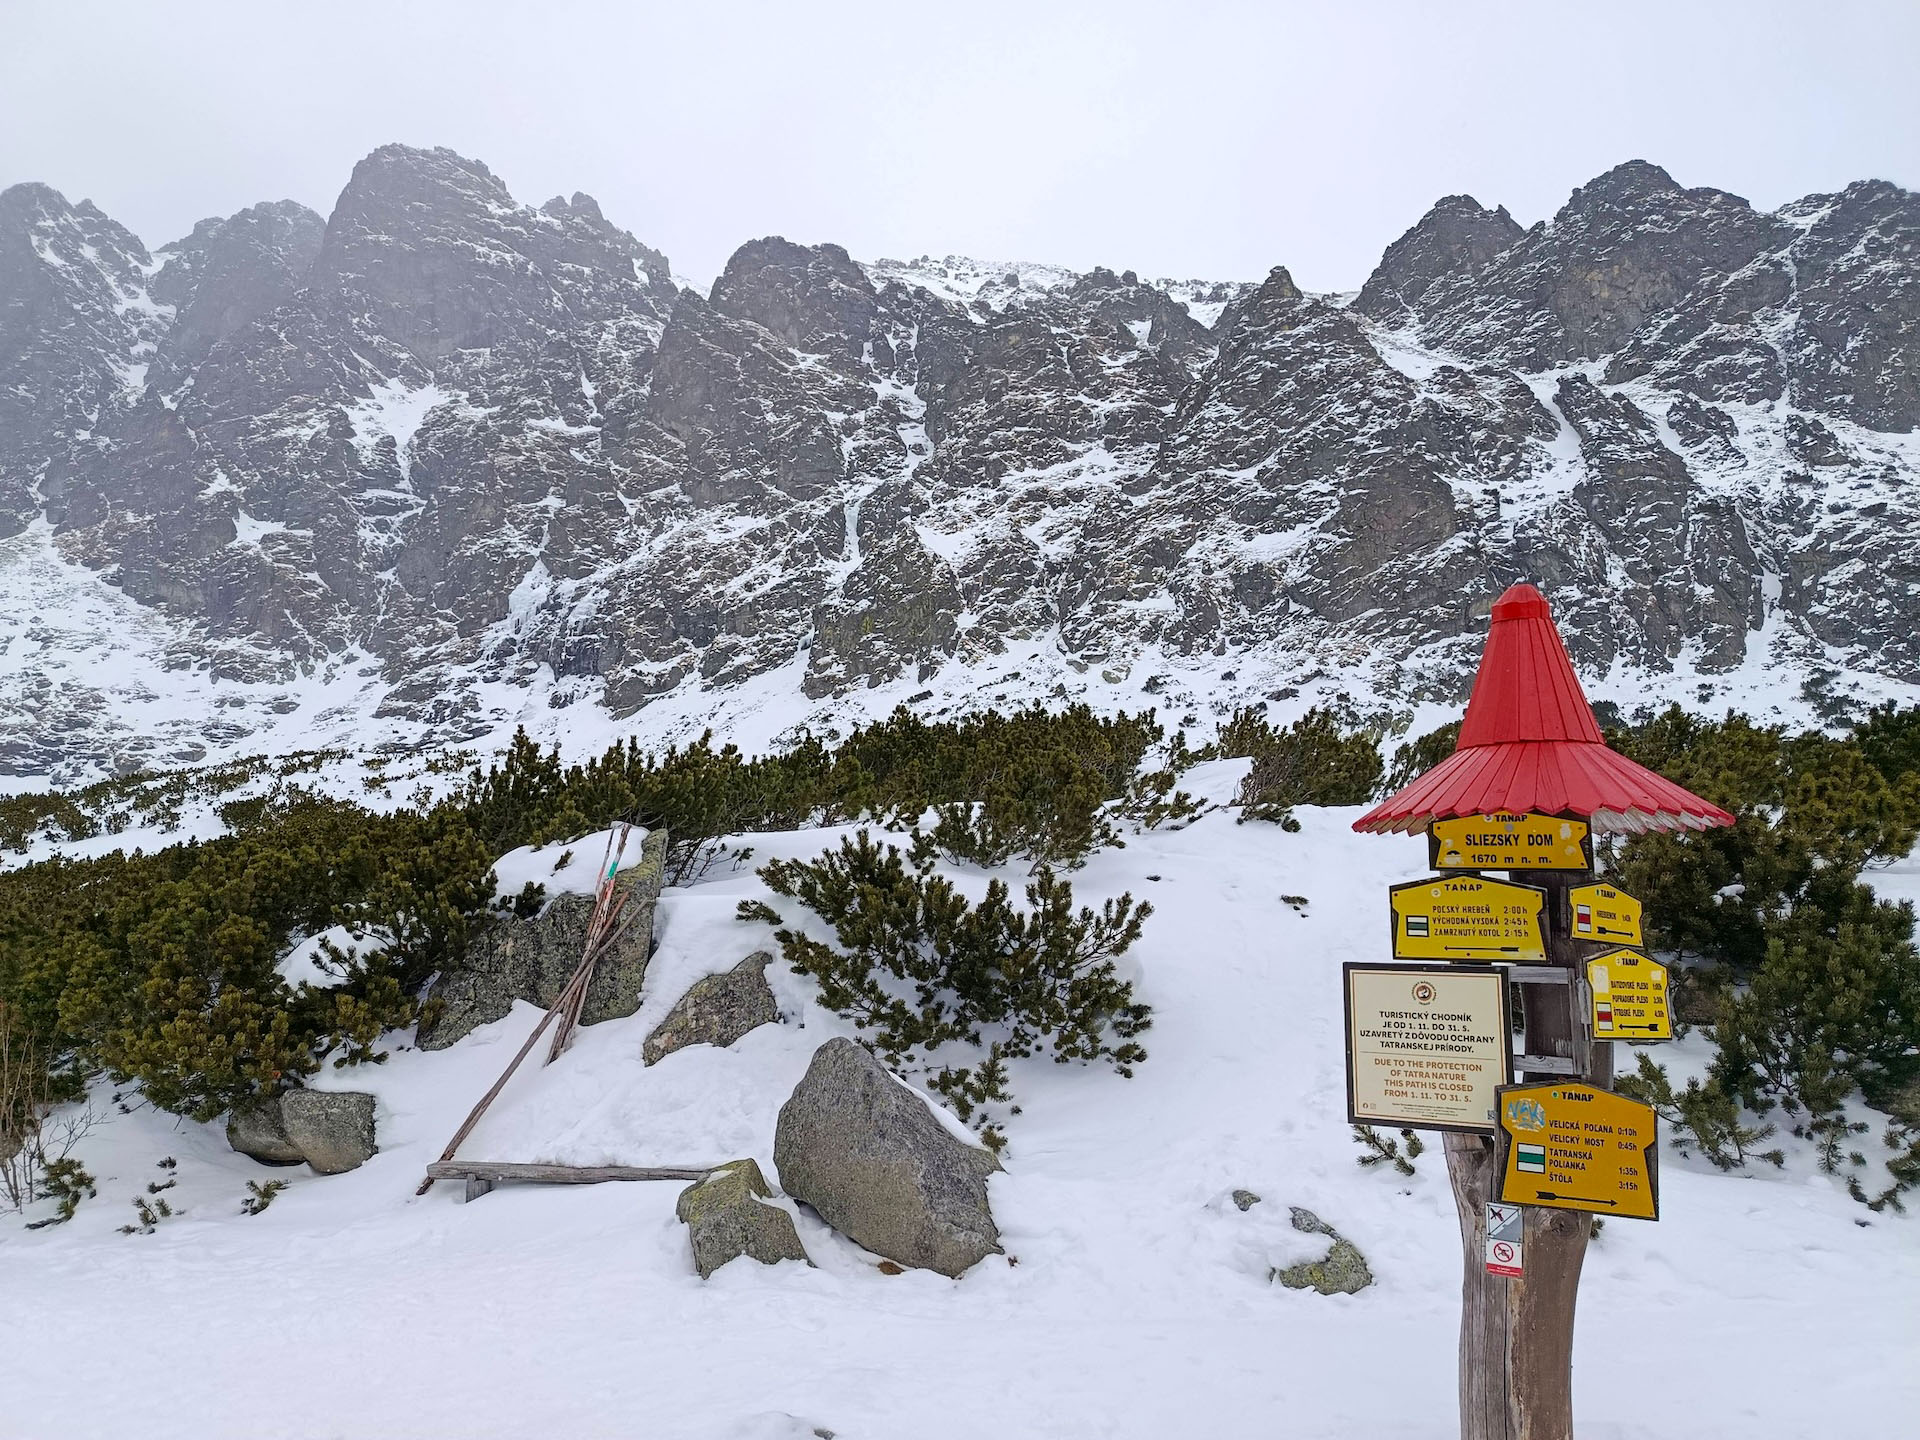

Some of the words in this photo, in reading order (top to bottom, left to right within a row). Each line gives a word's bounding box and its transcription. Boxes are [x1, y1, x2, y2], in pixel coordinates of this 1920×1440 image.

[1495, 814, 1528, 823] TANAP
[1465, 834, 1520, 846] SLIEZSKY
[1528, 834, 1553, 846] DOM
[1471, 854, 1497, 863] 1670
[1538, 856, 1552, 864] m.
[1444, 883, 1483, 891] TANAP
[1462, 904, 1490, 914] HREBEŇ
[1432, 915, 1469, 925] VÝCHODNÁ
[1471, 915, 1499, 925] VYSOKÁ
[1434, 927, 1476, 937] ZAMRZNUTÝ
[1478, 929, 1500, 937] KOTOL
[1621, 958, 1639, 966] TANAP
[1379, 1010, 1429, 1021] TURISTICKÝ
[1431, 1011, 1472, 1022] CHODNÍK
[1432, 1023, 1445, 1031] DO
[1448, 1024, 1460, 1032] 31.
[1360, 1030, 1403, 1039] UZAVRETÝ
[1411, 1031, 1449, 1041] DÔVODU
[1450, 1034, 1495, 1043] OCHRANY
[1380, 1040, 1434, 1050] TATRANSKEJ
[1435, 1042, 1474, 1053] PRÍRODY.
[1375, 1058, 1392, 1066] DUE
[1393, 1059, 1405, 1067] TO
[1407, 1060, 1424, 1068] THE
[1426, 1061, 1482, 1072] PROTECTION
[1390, 1069, 1401, 1077] OF
[1404, 1070, 1431, 1079] TATRA
[1431, 1072, 1466, 1081] NATURE
[1384, 1079, 1404, 1087] THIS
[1405, 1081, 1428, 1089] PATH
[1438, 1083, 1473, 1092] CLOSED
[1384, 1089, 1408, 1098] FROM
[1411, 1091, 1418, 1099] 1.
[1420, 1092, 1432, 1100] 11.
[1434, 1093, 1447, 1101] TO
[1449, 1094, 1462, 1102] 31.
[1464, 1095, 1472, 1103] 5.
[1561, 1091, 1594, 1102] TANAP
[1549, 1120, 1580, 1130] VELICKÁ
[1617, 1127, 1637, 1136] 0:10h
[1549, 1134, 1580, 1145] VELICKÝ
[1585, 1137, 1605, 1147] MOST
[1617, 1141, 1637, 1151] 0:45h
[1549, 1148, 1593, 1160] TATRANSKÁ
[1549, 1159, 1586, 1171] POLIANKA
[1619, 1167, 1638, 1176] 1:35h
[1549, 1173, 1573, 1184] ŠTÔLA
[1619, 1181, 1638, 1191] 3:15h
